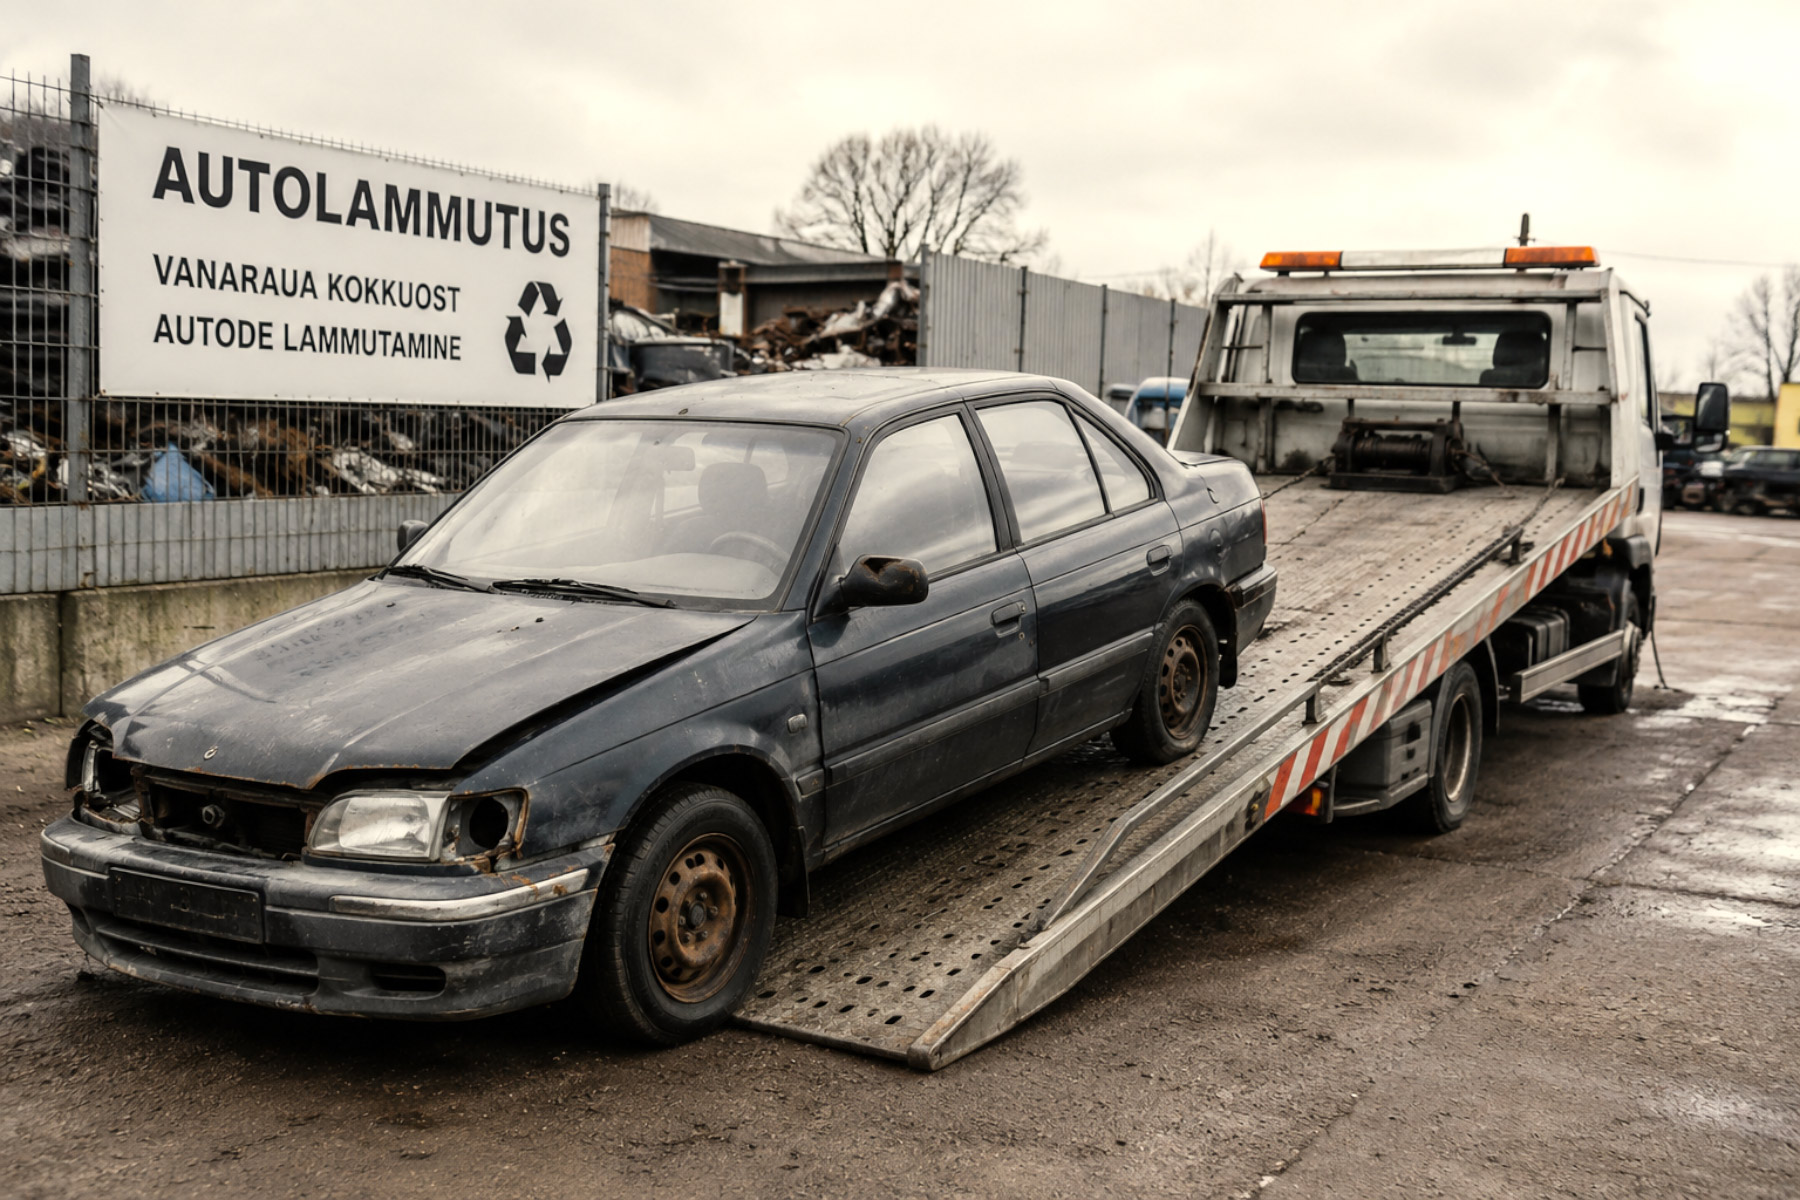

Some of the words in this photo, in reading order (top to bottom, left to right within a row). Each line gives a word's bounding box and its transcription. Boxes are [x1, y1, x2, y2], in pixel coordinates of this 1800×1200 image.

[152, 146, 570, 258] AUTOLAMMUTUS
[152, 253, 318, 300] VANARAUA
[328, 272, 461, 313] KOKKUOST
[153, 313, 274, 350] AUTODE
[284, 323, 461, 361] LAMMUTAMINE
